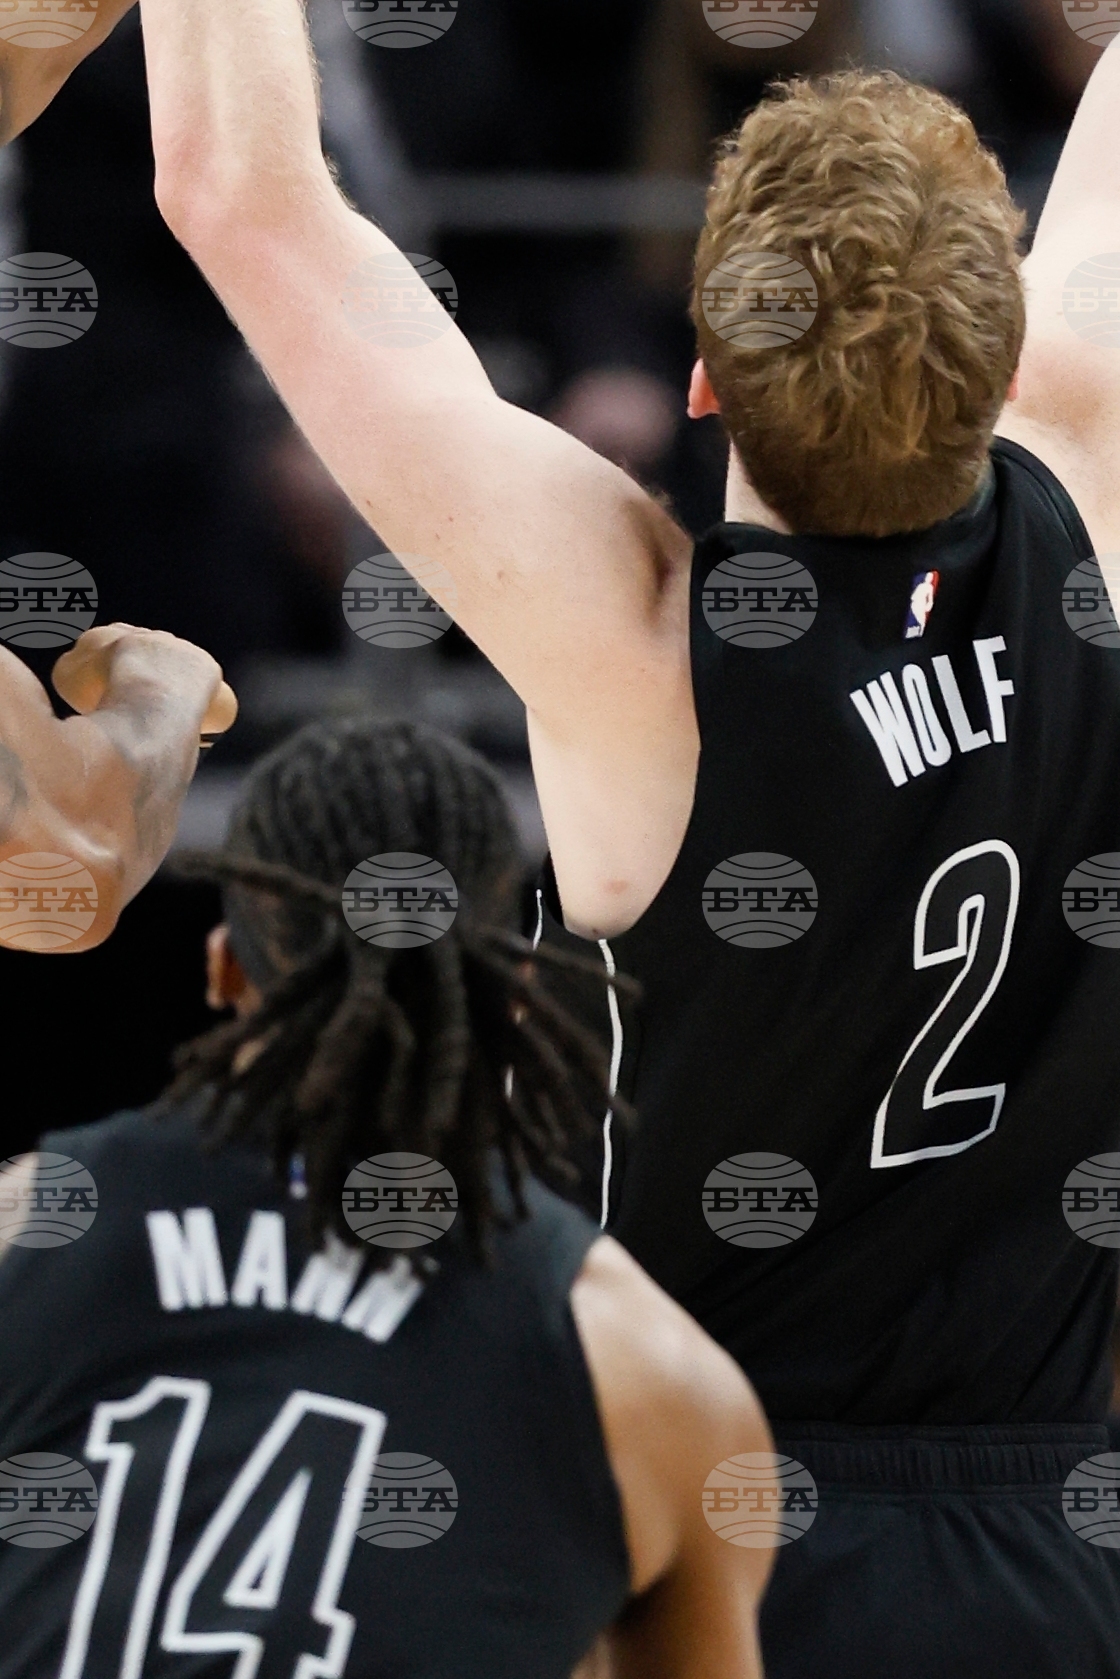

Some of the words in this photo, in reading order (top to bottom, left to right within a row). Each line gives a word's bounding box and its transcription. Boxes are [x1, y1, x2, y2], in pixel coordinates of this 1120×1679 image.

[849, 634, 1015, 788] WOLF
[870, 839, 1020, 1169] 2
[145, 1206, 440, 1345] MANN
[60, 1375, 388, 1679] 14
